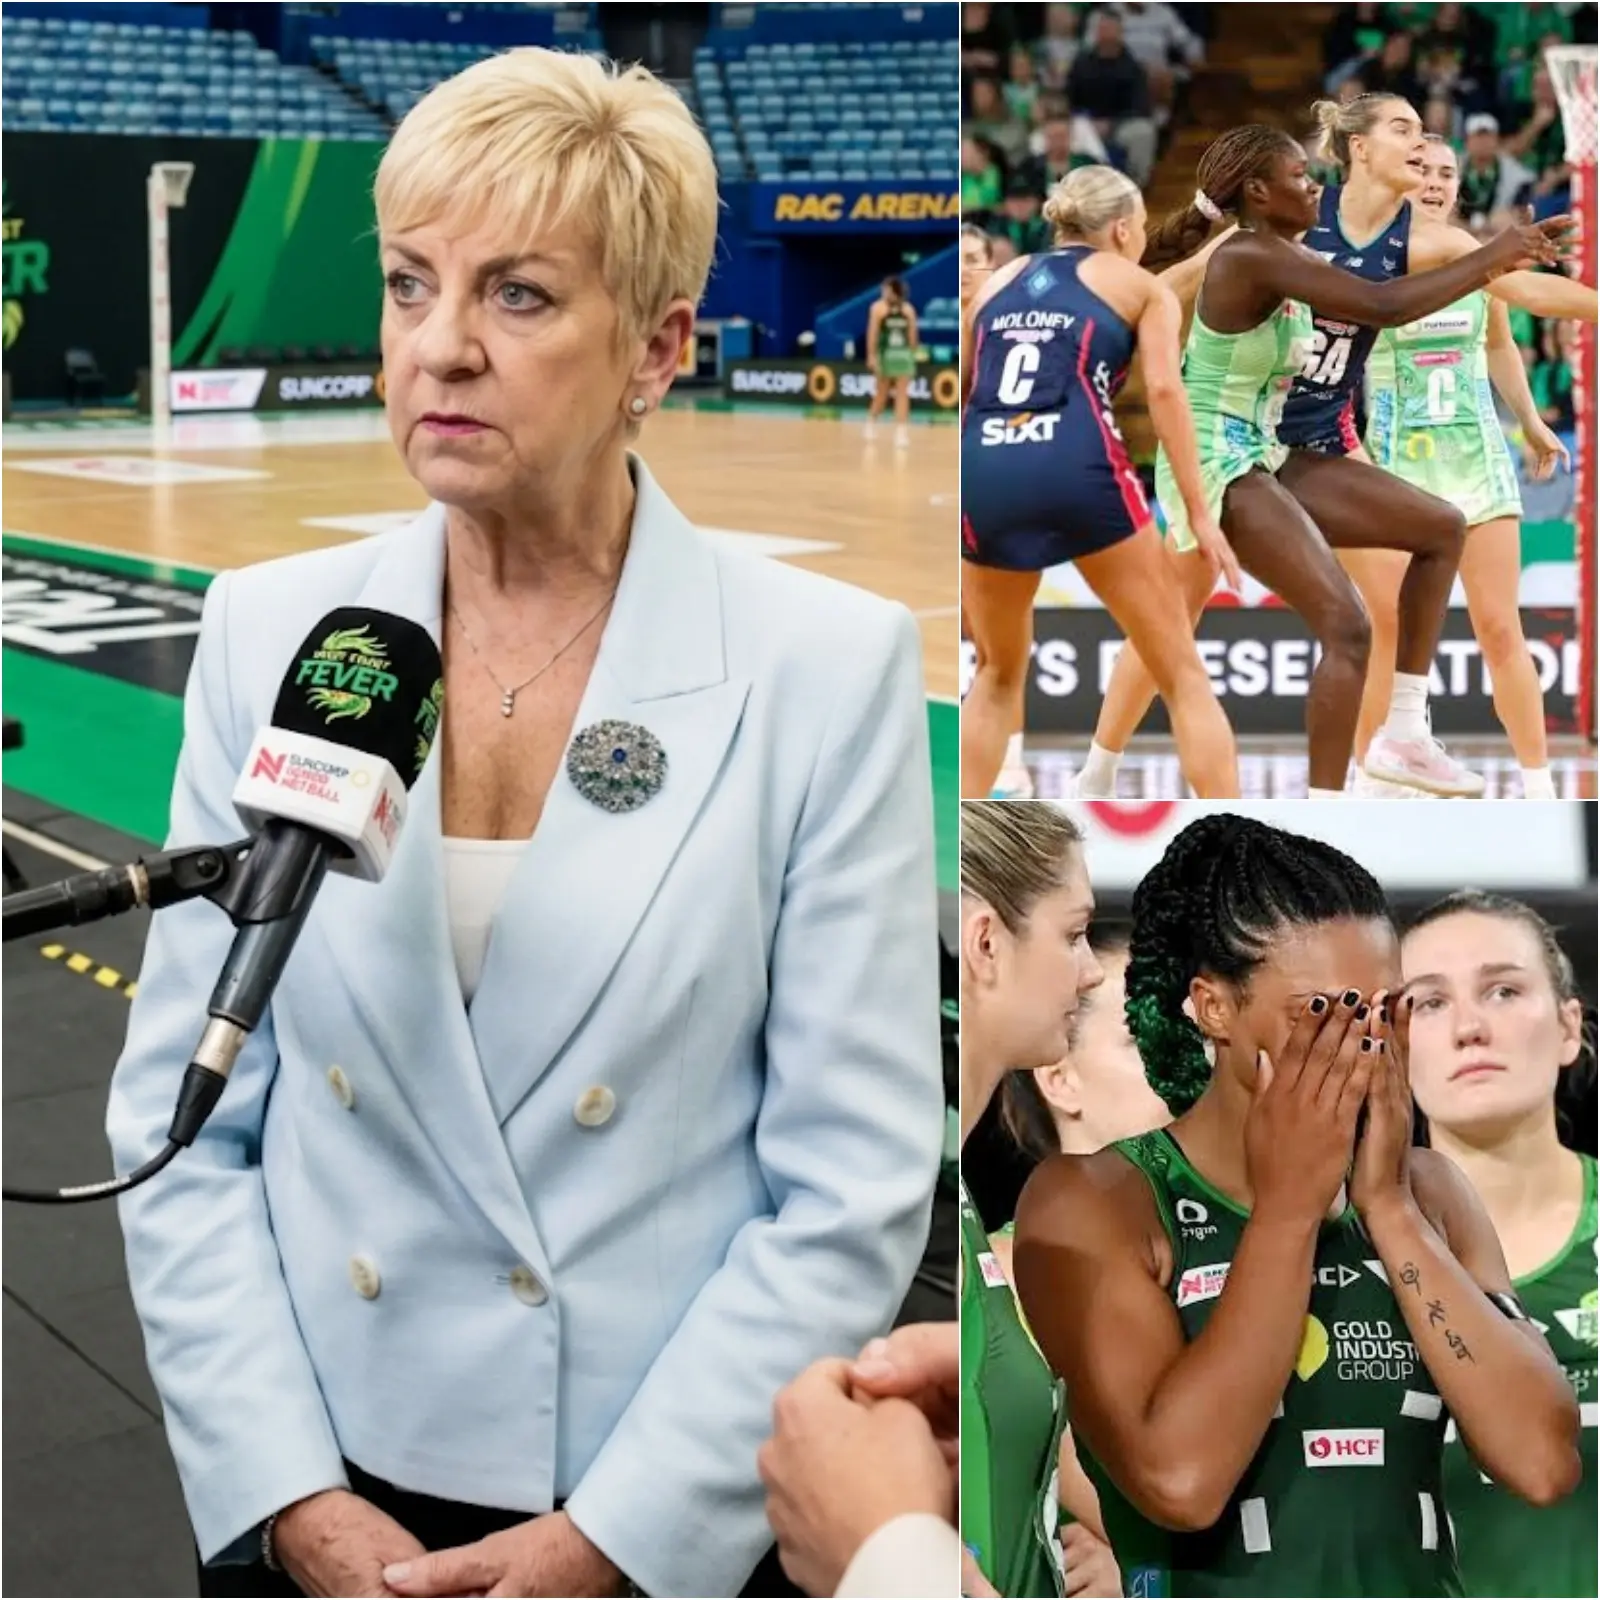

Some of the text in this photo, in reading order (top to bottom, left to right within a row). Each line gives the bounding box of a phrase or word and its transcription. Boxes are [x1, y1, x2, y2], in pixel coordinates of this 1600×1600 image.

[774, 193, 843, 221] RAC
[997, 343, 1041, 405] C
[1427, 367, 1455, 423] C
[295, 659, 400, 702] FEVER
[1333, 1321, 1393, 1340] GOLD
[1337, 1360, 1414, 1381] GROUP
[1335, 1438, 1379, 1456] HCF
